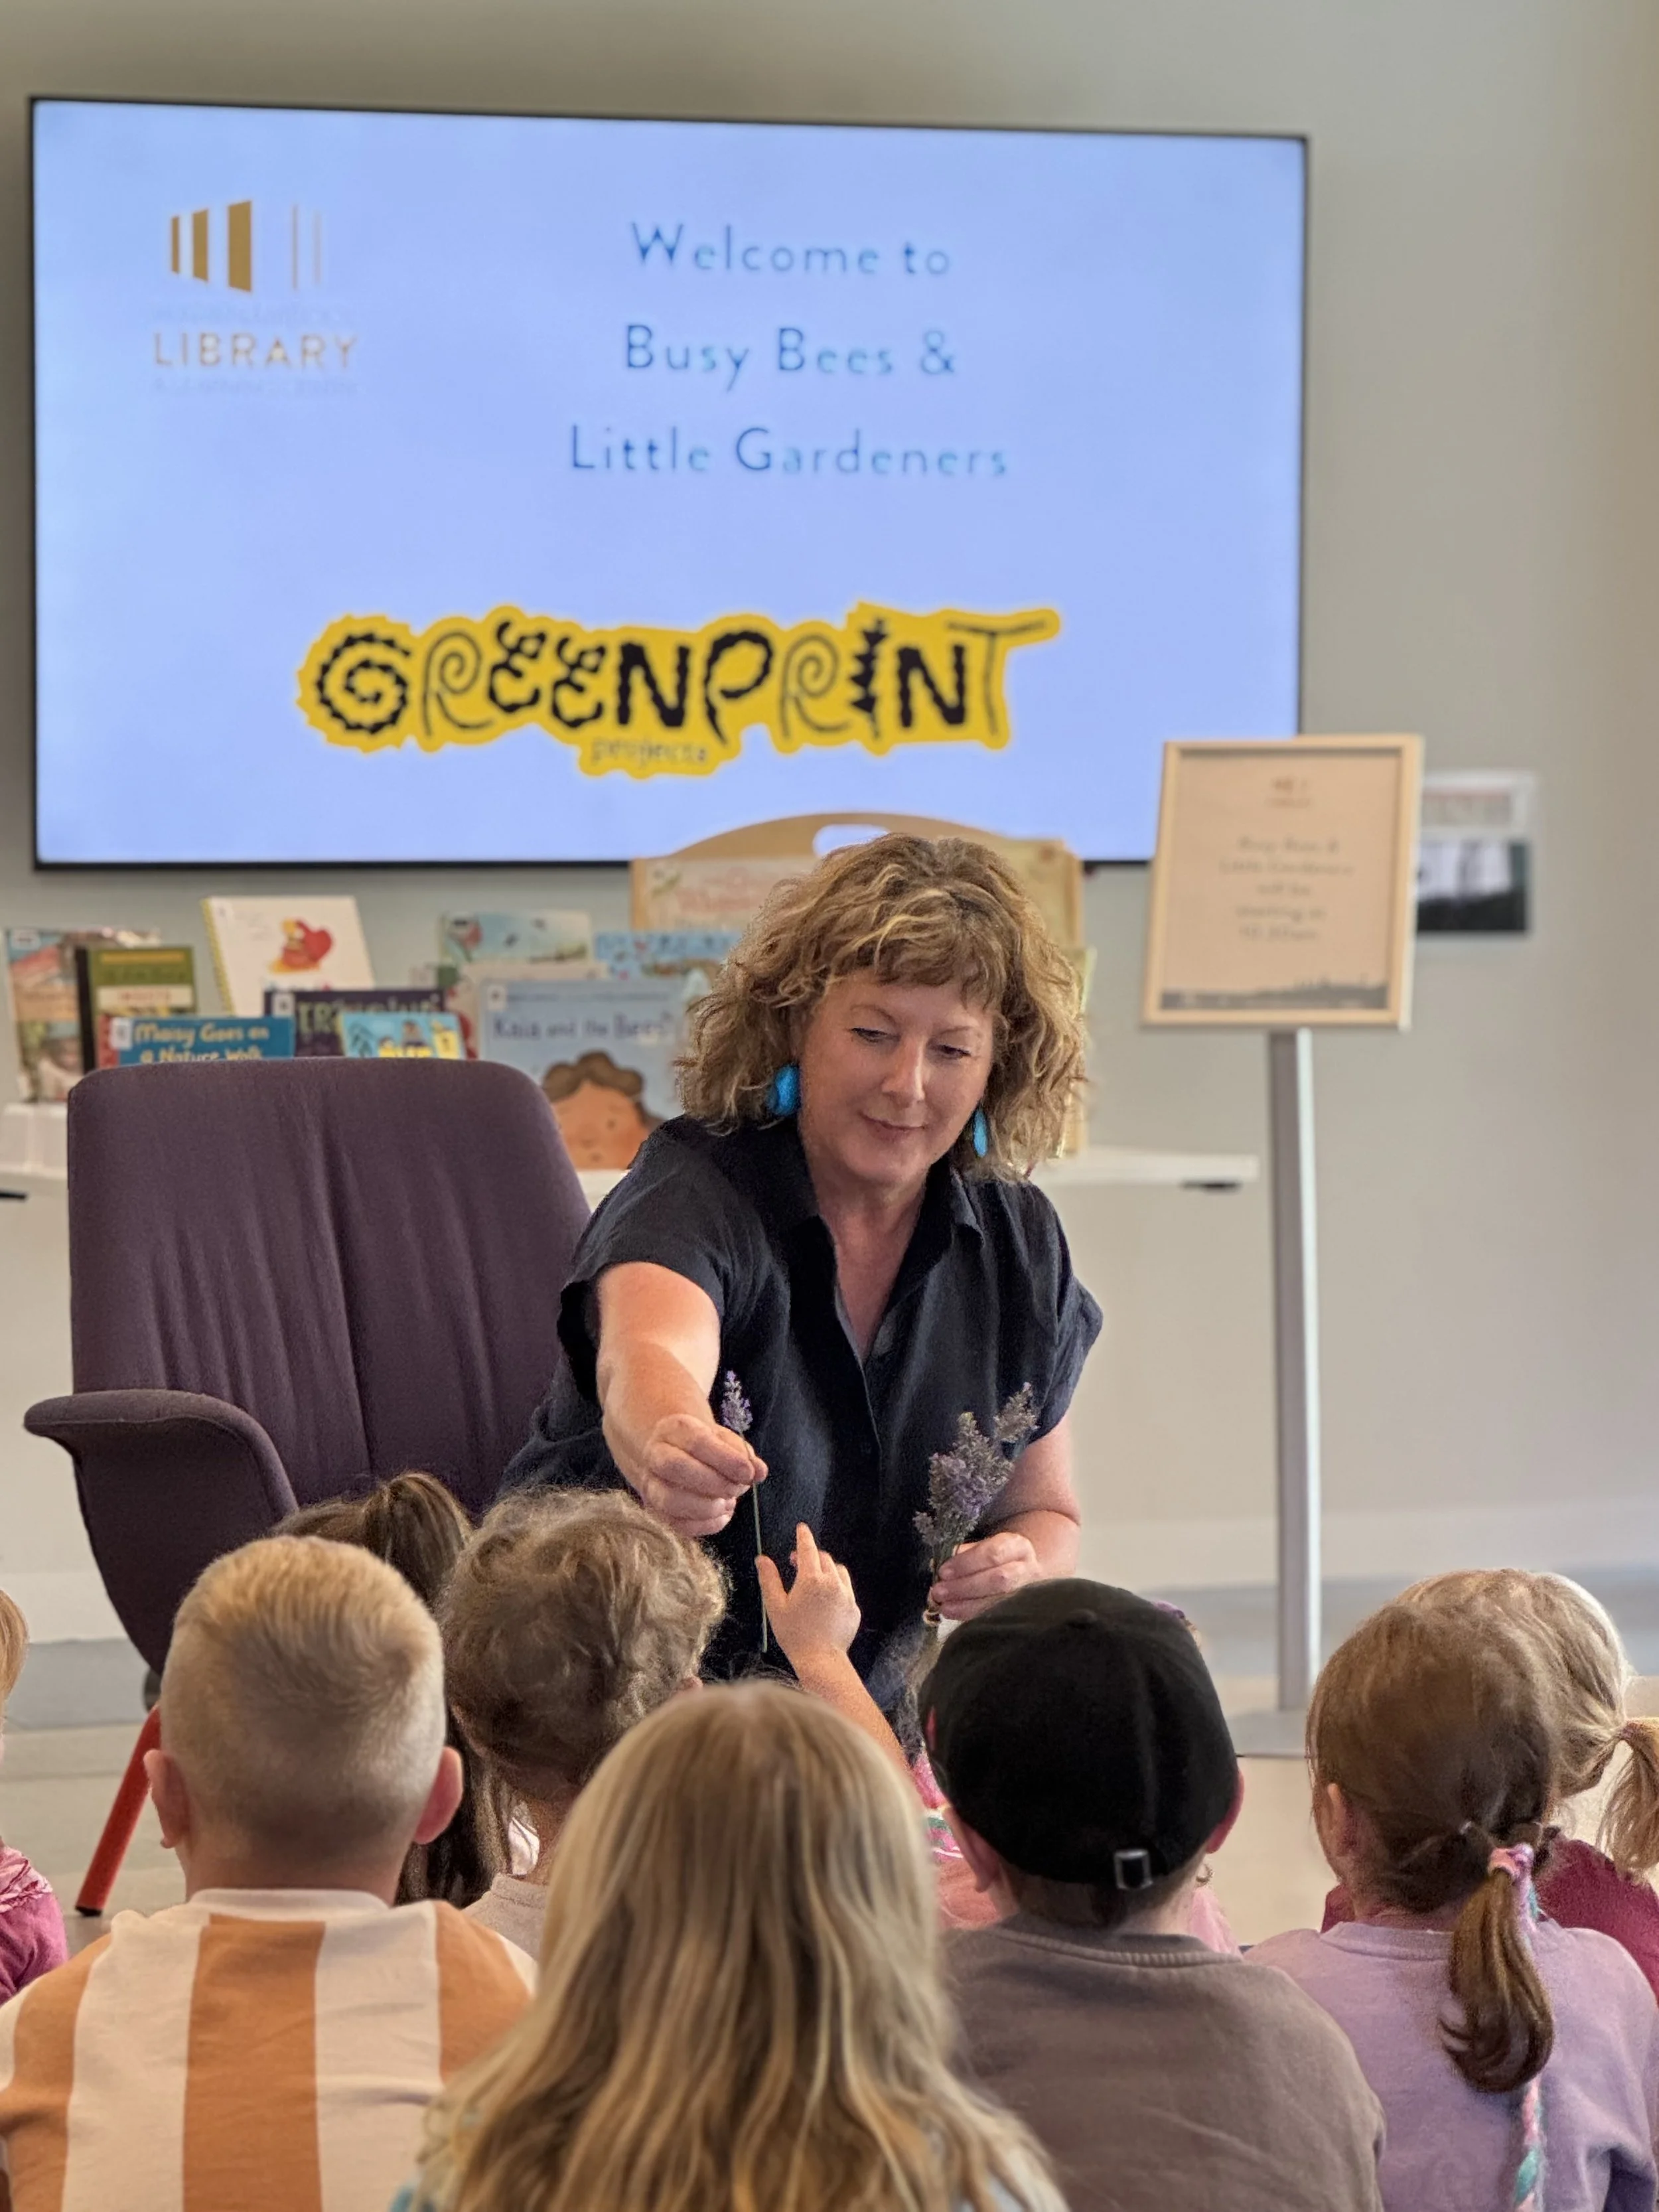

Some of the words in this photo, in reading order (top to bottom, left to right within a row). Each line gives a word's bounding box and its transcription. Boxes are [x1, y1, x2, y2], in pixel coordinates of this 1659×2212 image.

[630, 222, 879, 273] Welcome
[902, 241, 951, 275] to
[154, 332, 357, 370] LIBRARY
[626, 324, 750, 393] Busy
[778, 327, 893, 376] Bees
[919, 329, 957, 376] &
[571, 423, 711, 471] Little
[735, 425, 1007, 477] Gardeners
